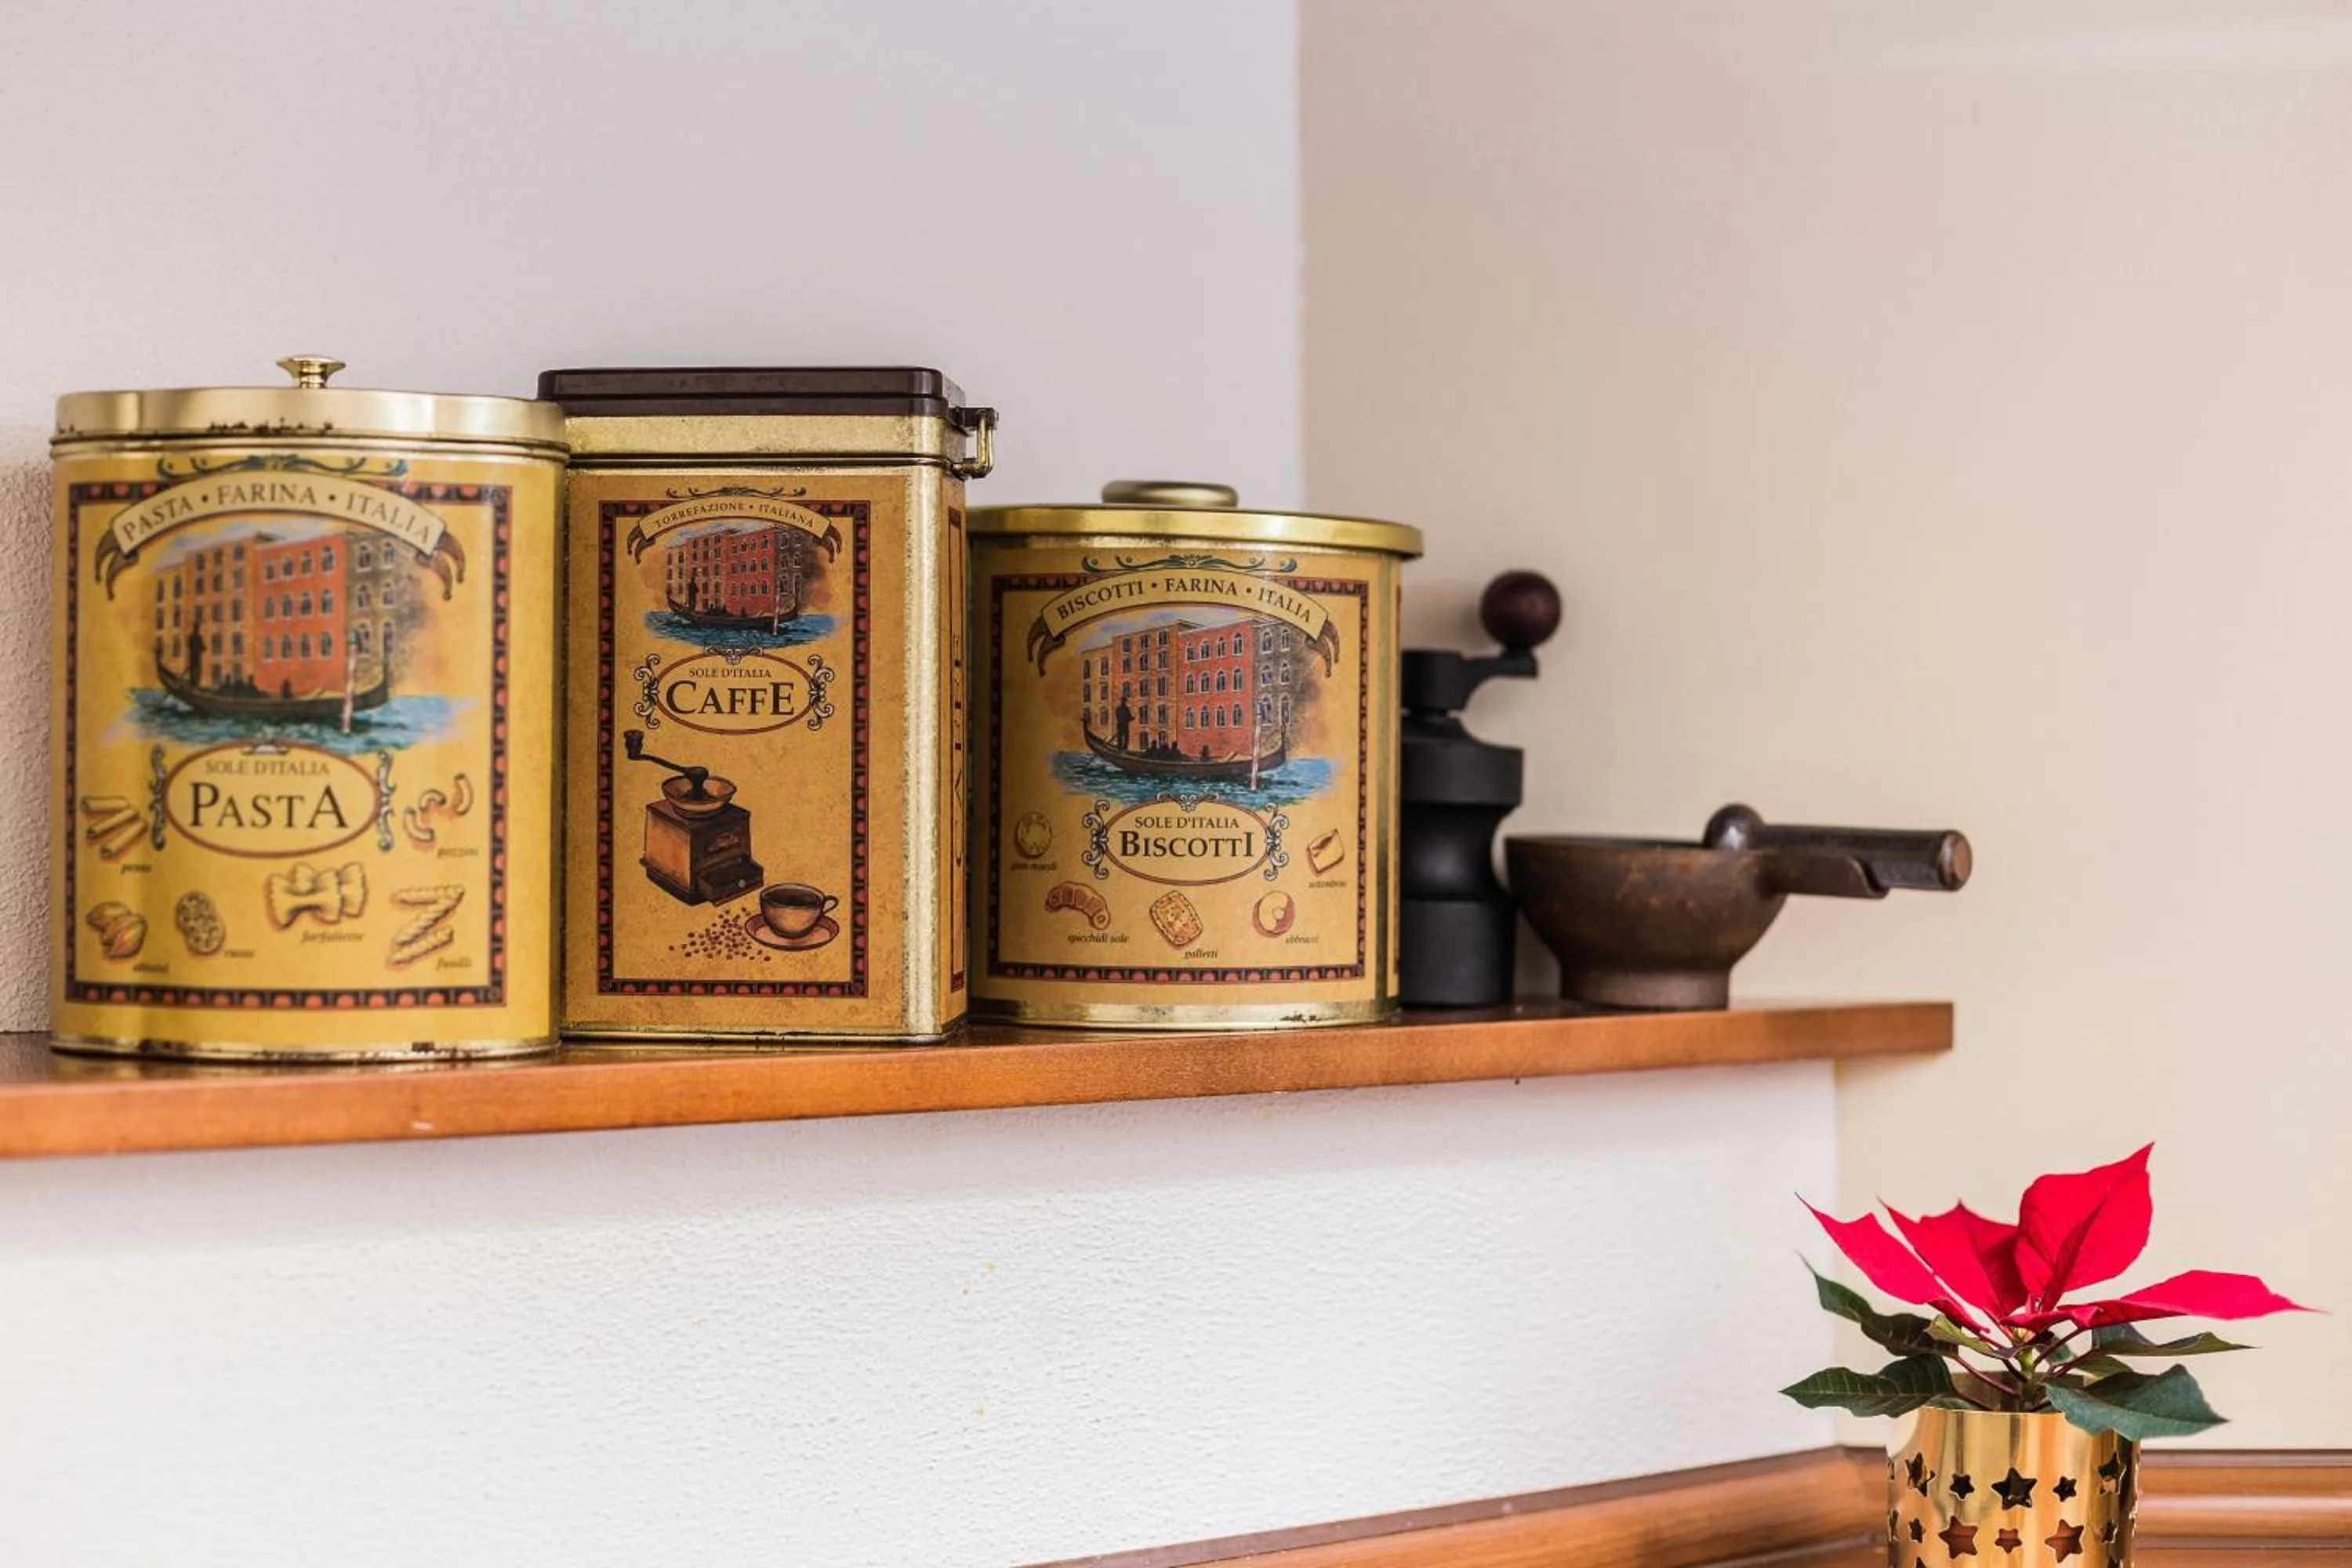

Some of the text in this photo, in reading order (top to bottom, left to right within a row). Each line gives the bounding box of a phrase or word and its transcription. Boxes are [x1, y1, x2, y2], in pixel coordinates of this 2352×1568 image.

[122, 483, 430, 544] PASTA FARINA ITALIA
[654, 502, 814, 528] TORREFAZIONE ITALIANA
[1056, 577, 1312, 623] BISCOTTI FARINA ITALIA
[688, 668, 719, 678] SOLE
[666, 680, 795, 716] CAFFE
[205, 759, 245, 775] SOLE
[189, 781, 349, 829] PASTA
[1134, 816, 1240, 829] SOLE D'ITALIA
[1118, 830, 1254, 858] BISCOTTI
